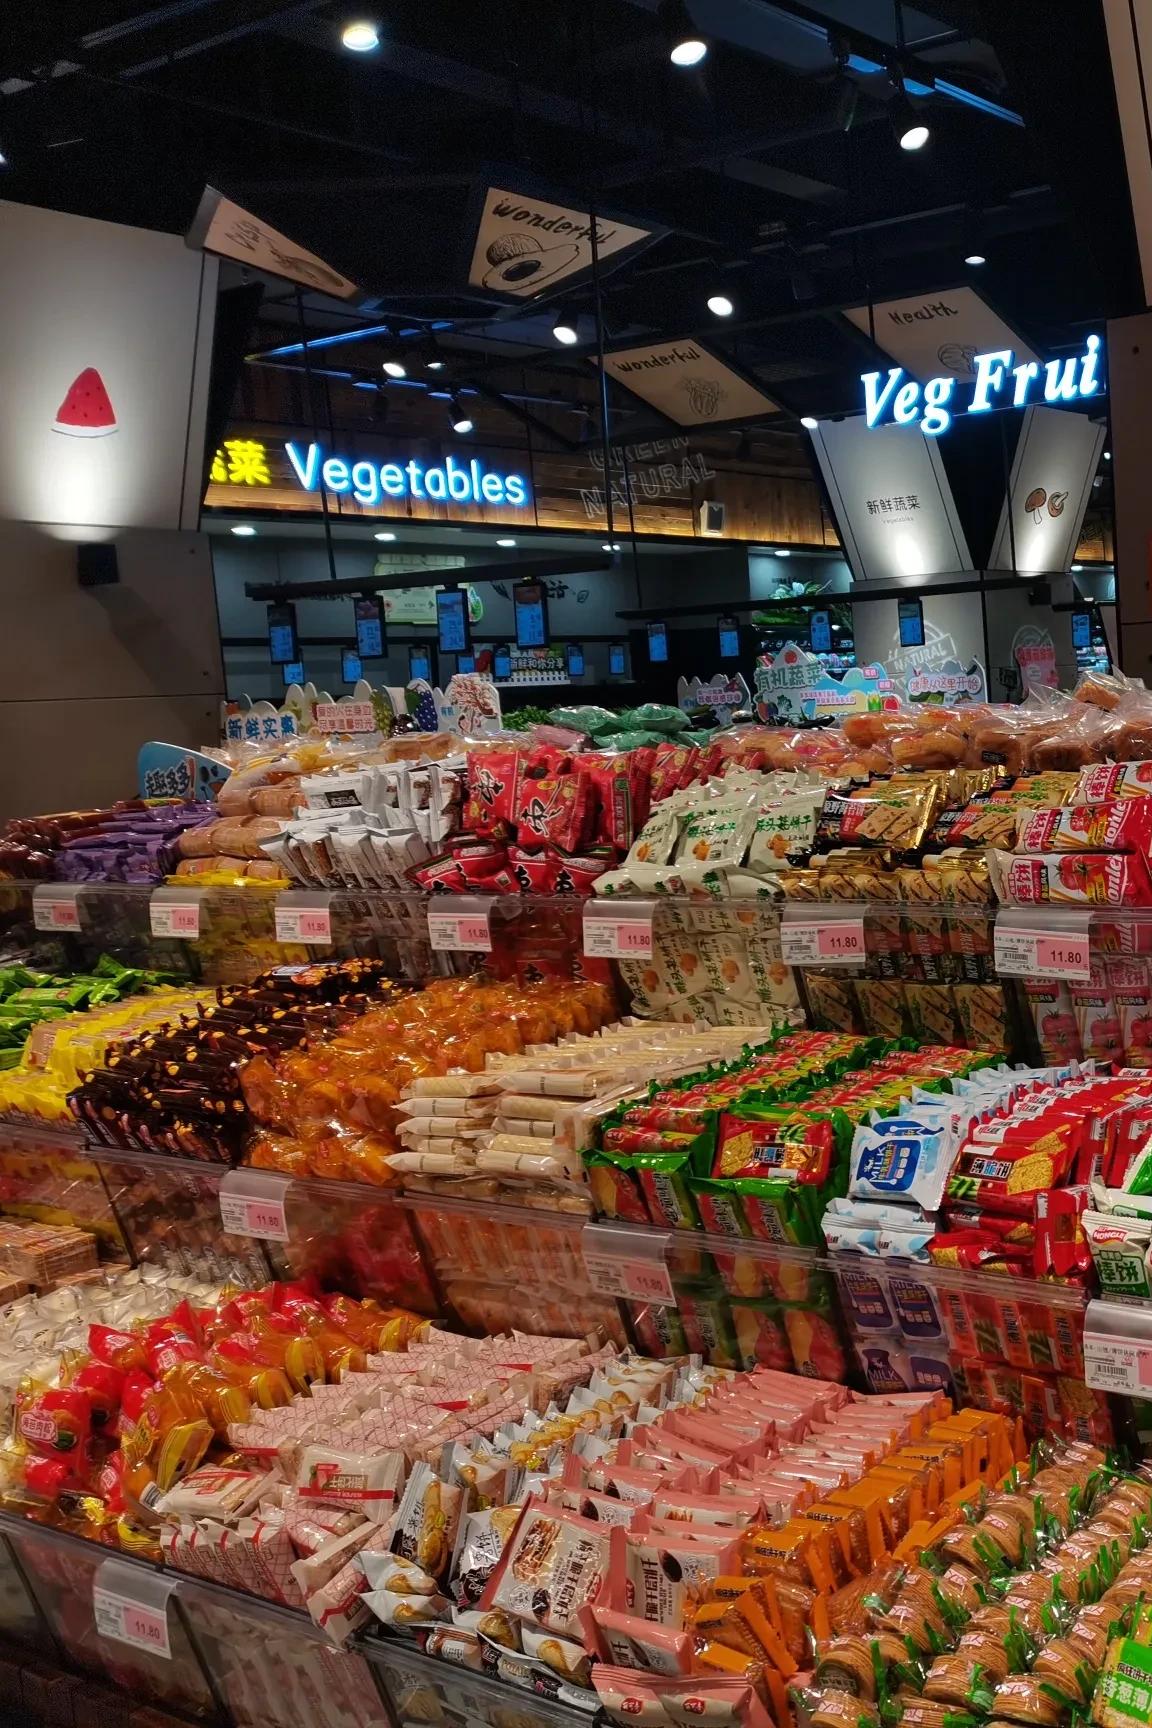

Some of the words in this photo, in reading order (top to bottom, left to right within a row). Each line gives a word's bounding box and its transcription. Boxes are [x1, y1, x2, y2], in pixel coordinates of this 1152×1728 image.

[888, 301, 958, 325] Health
[861, 367, 954, 435] Veg
[967, 334, 1100, 412] Frui
[285, 441, 526, 505] Vegetables
[580, 453, 717, 519] NATURAL
[866, 495, 921, 515] 新鲜蔬菜
[894, 643, 947, 672] NATURAL
[756, 664, 823, 691] 有机蔬菜
[227, 713, 295, 740] 新鲜实惠
[829, 936, 858, 949] 11.80
[1050, 950, 1082, 965] 11.80
[869, 1145, 888, 1182] MILK
[970, 1158, 1013, 1179] 薄脆饼
[1094, 1229, 1126, 1241] HONGLE
[1097, 1260, 1139, 1283] 棒饼
[134, 1620, 161, 1640] 11.80
